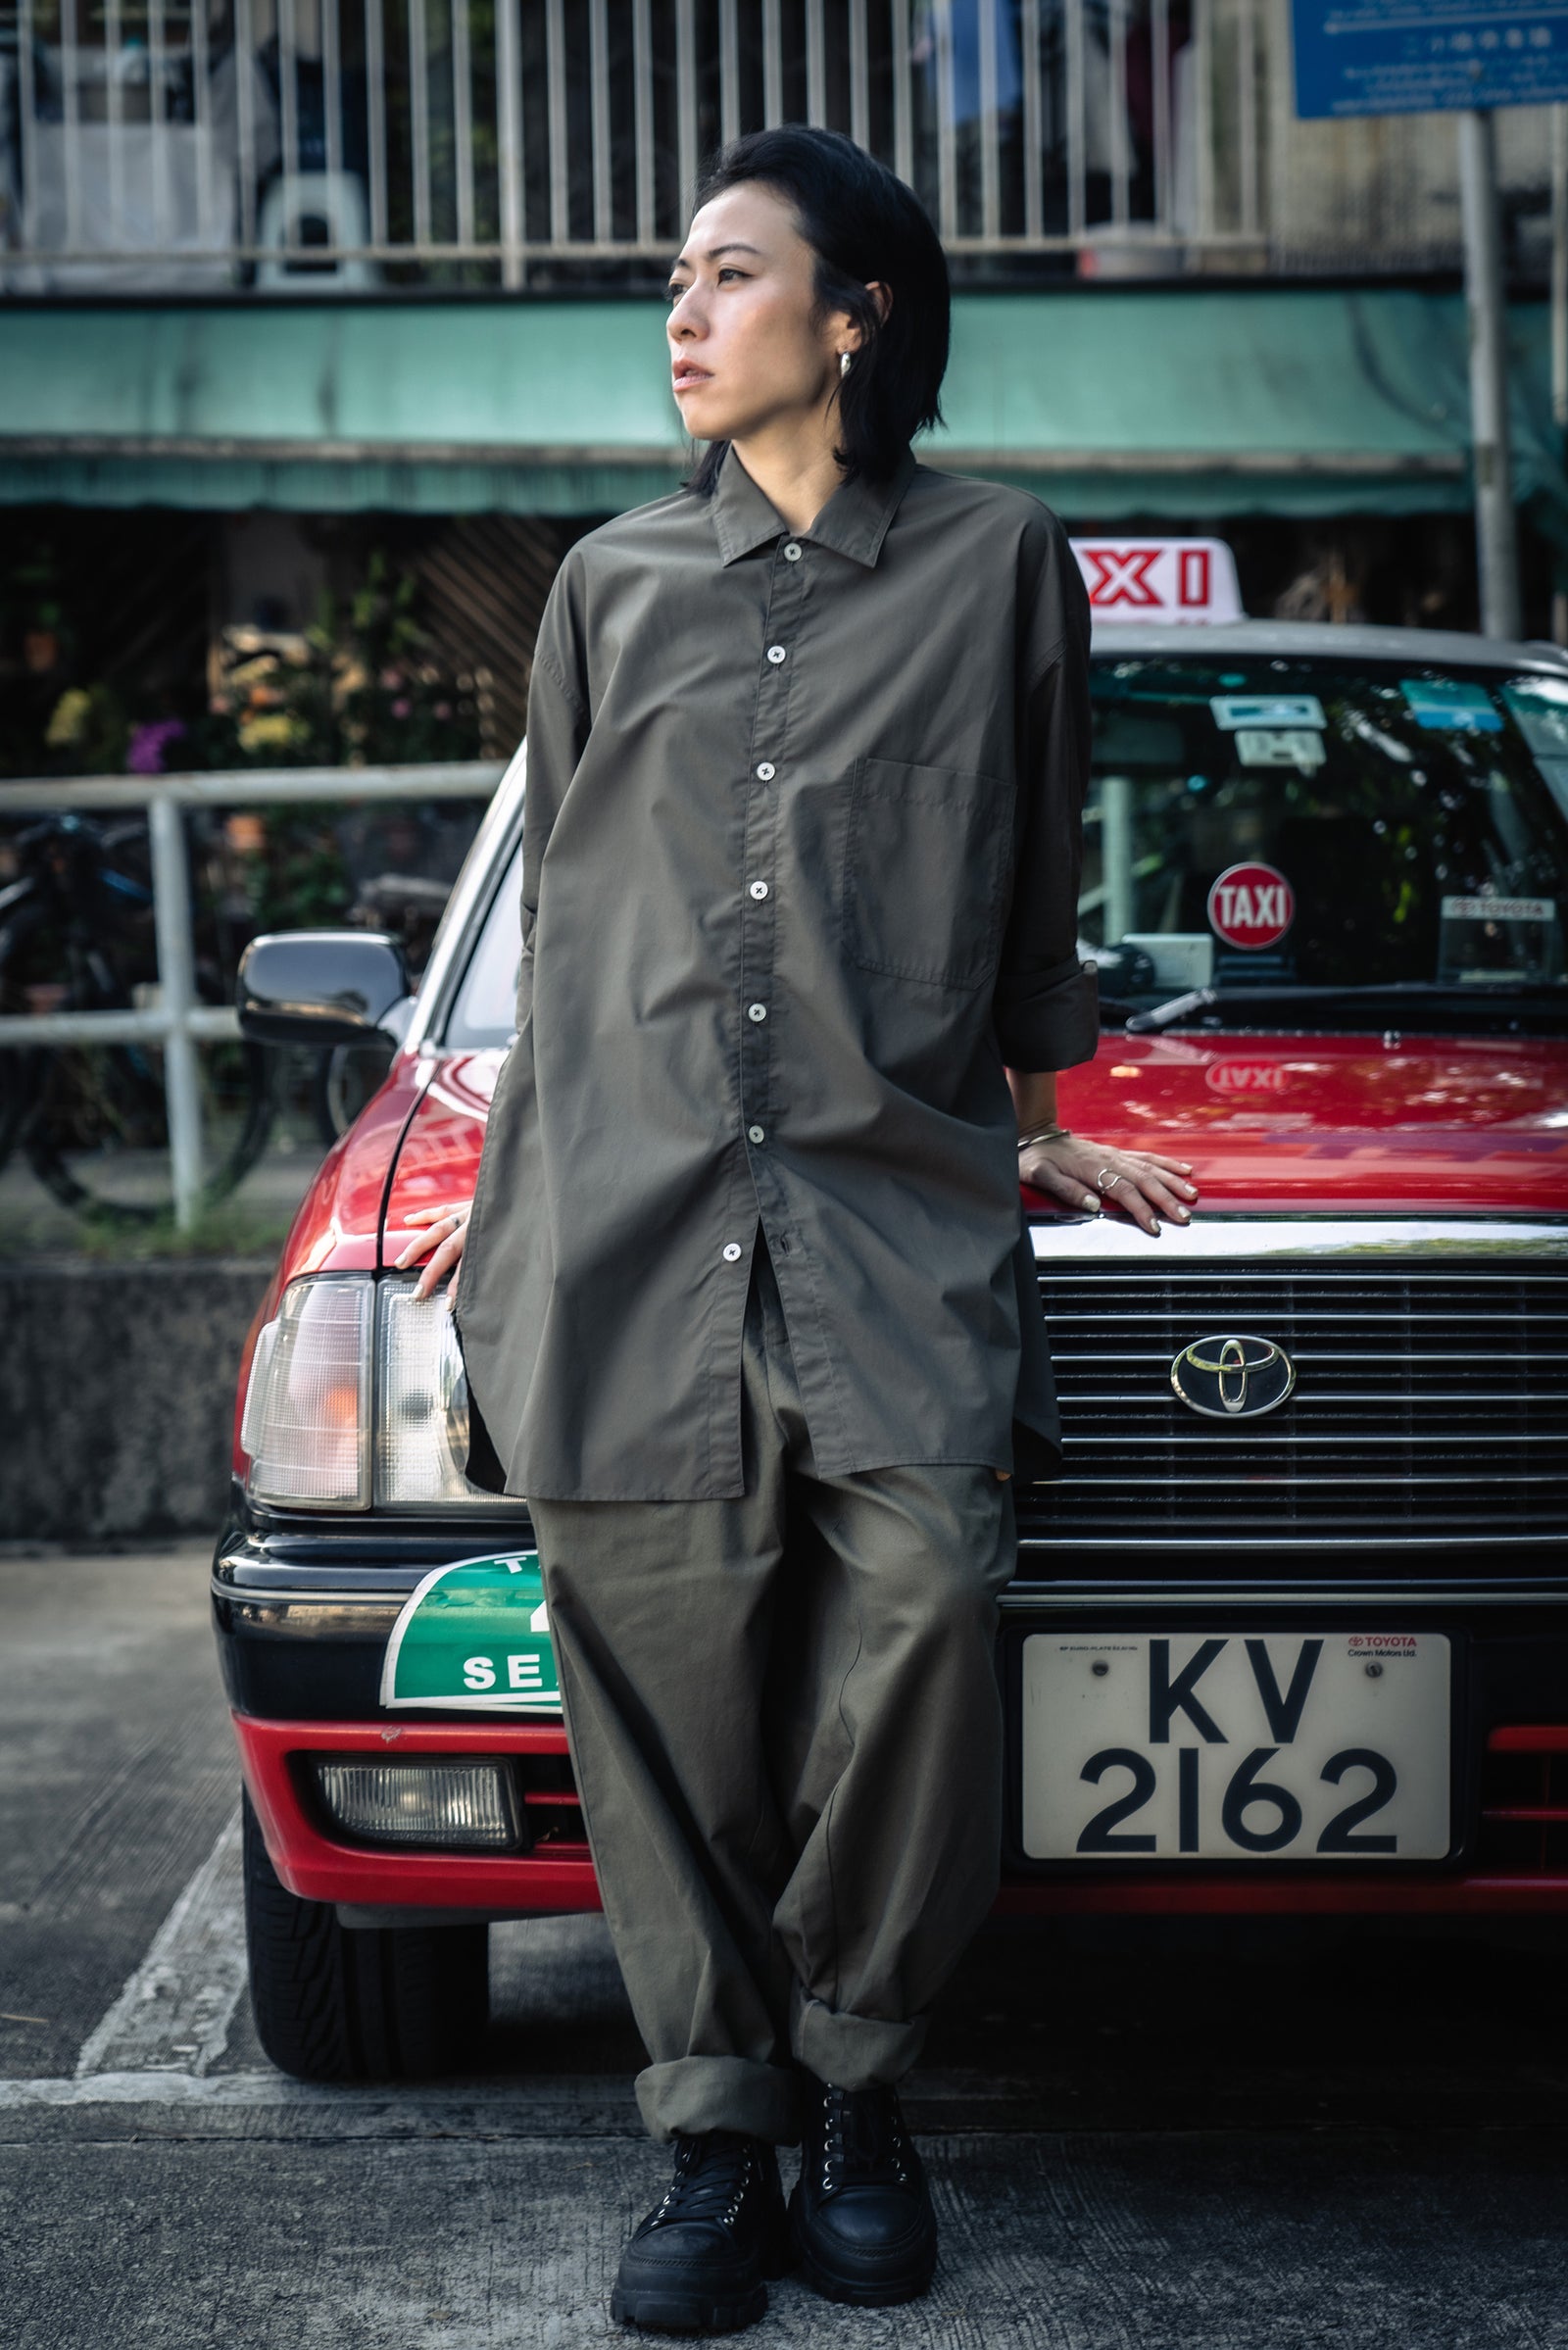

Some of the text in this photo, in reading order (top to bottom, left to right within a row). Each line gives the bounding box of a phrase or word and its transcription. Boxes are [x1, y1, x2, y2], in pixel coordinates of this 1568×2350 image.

[1219, 884, 1286, 928] TAXI
[1348, 1648, 1374, 1657] Crown
[1375, 1648, 1401, 1657] Motors
[1365, 1637, 1417, 1647] TOYOTA
[464, 1654, 559, 1689] SE
[1150, 1640, 1325, 1743] KV
[1076, 1747, 1397, 1852] 2162
